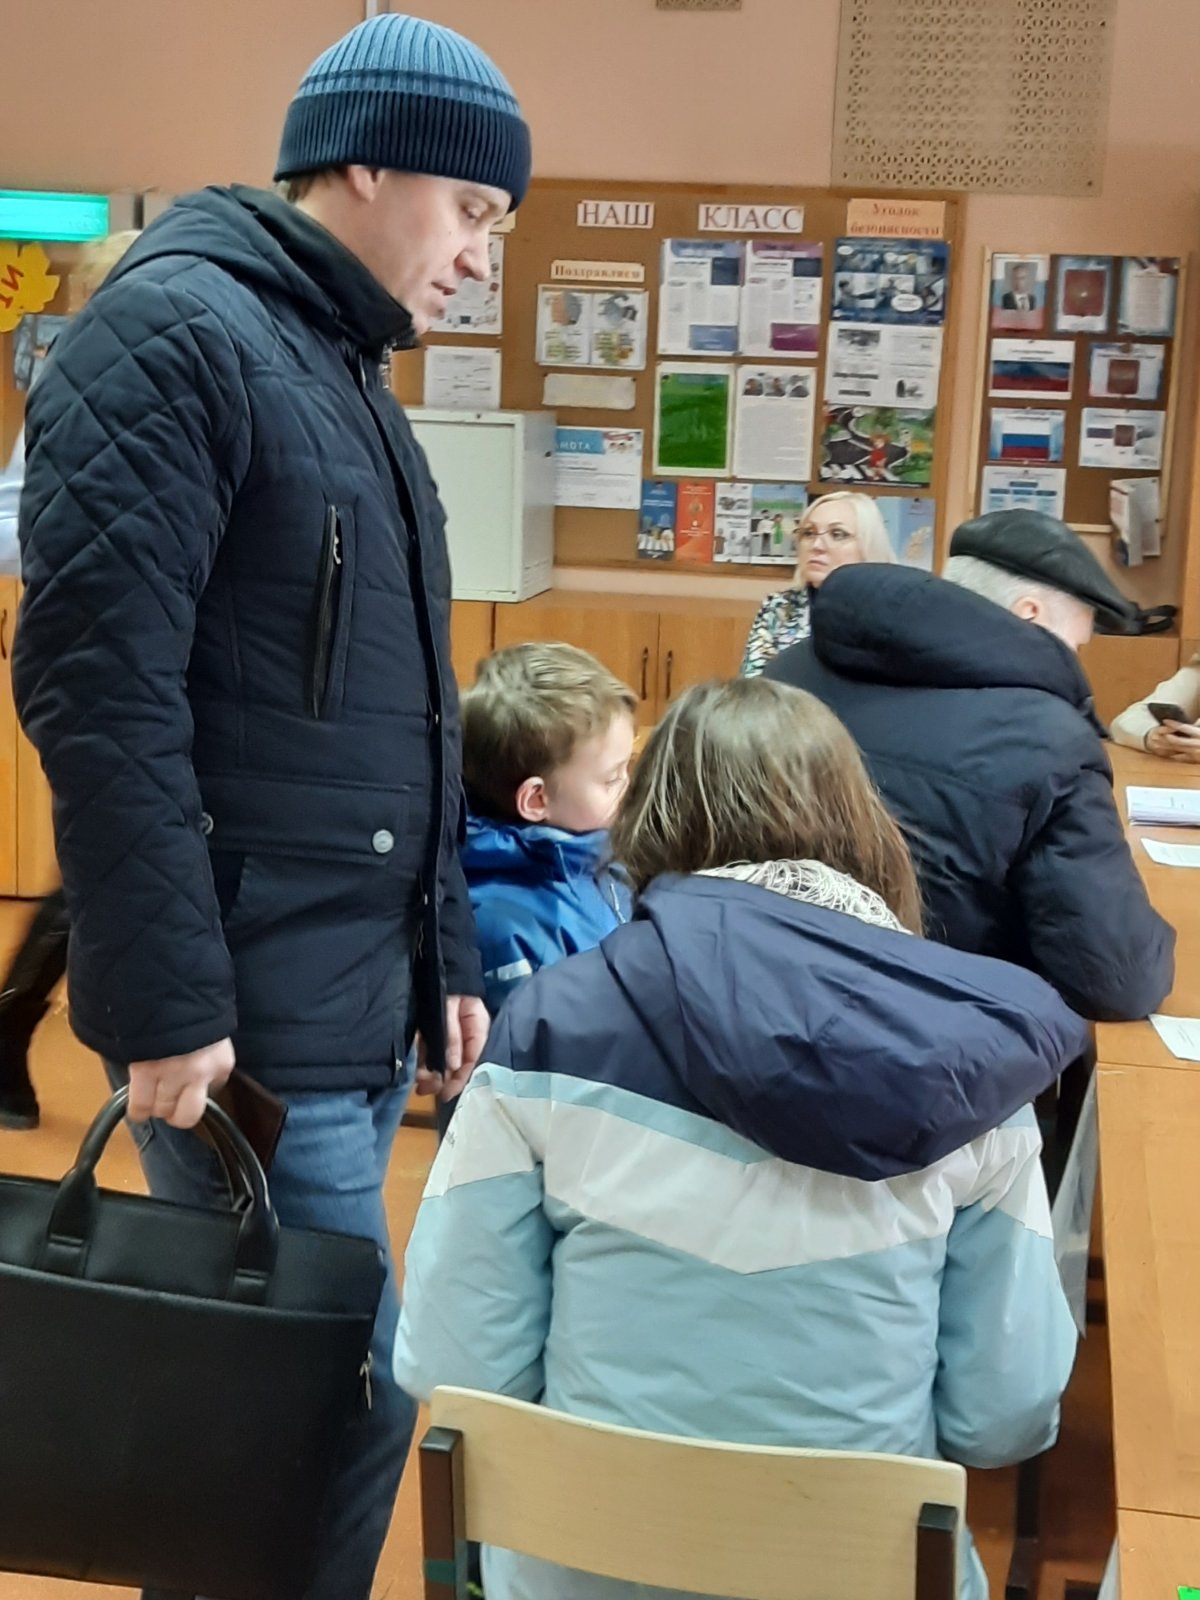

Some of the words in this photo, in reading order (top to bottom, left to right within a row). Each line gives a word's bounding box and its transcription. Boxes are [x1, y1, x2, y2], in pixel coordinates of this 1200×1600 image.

[582, 202, 650, 226] НАШ
[703, 206, 801, 231] КЛАСС
[873, 202, 919, 217] Уголок
